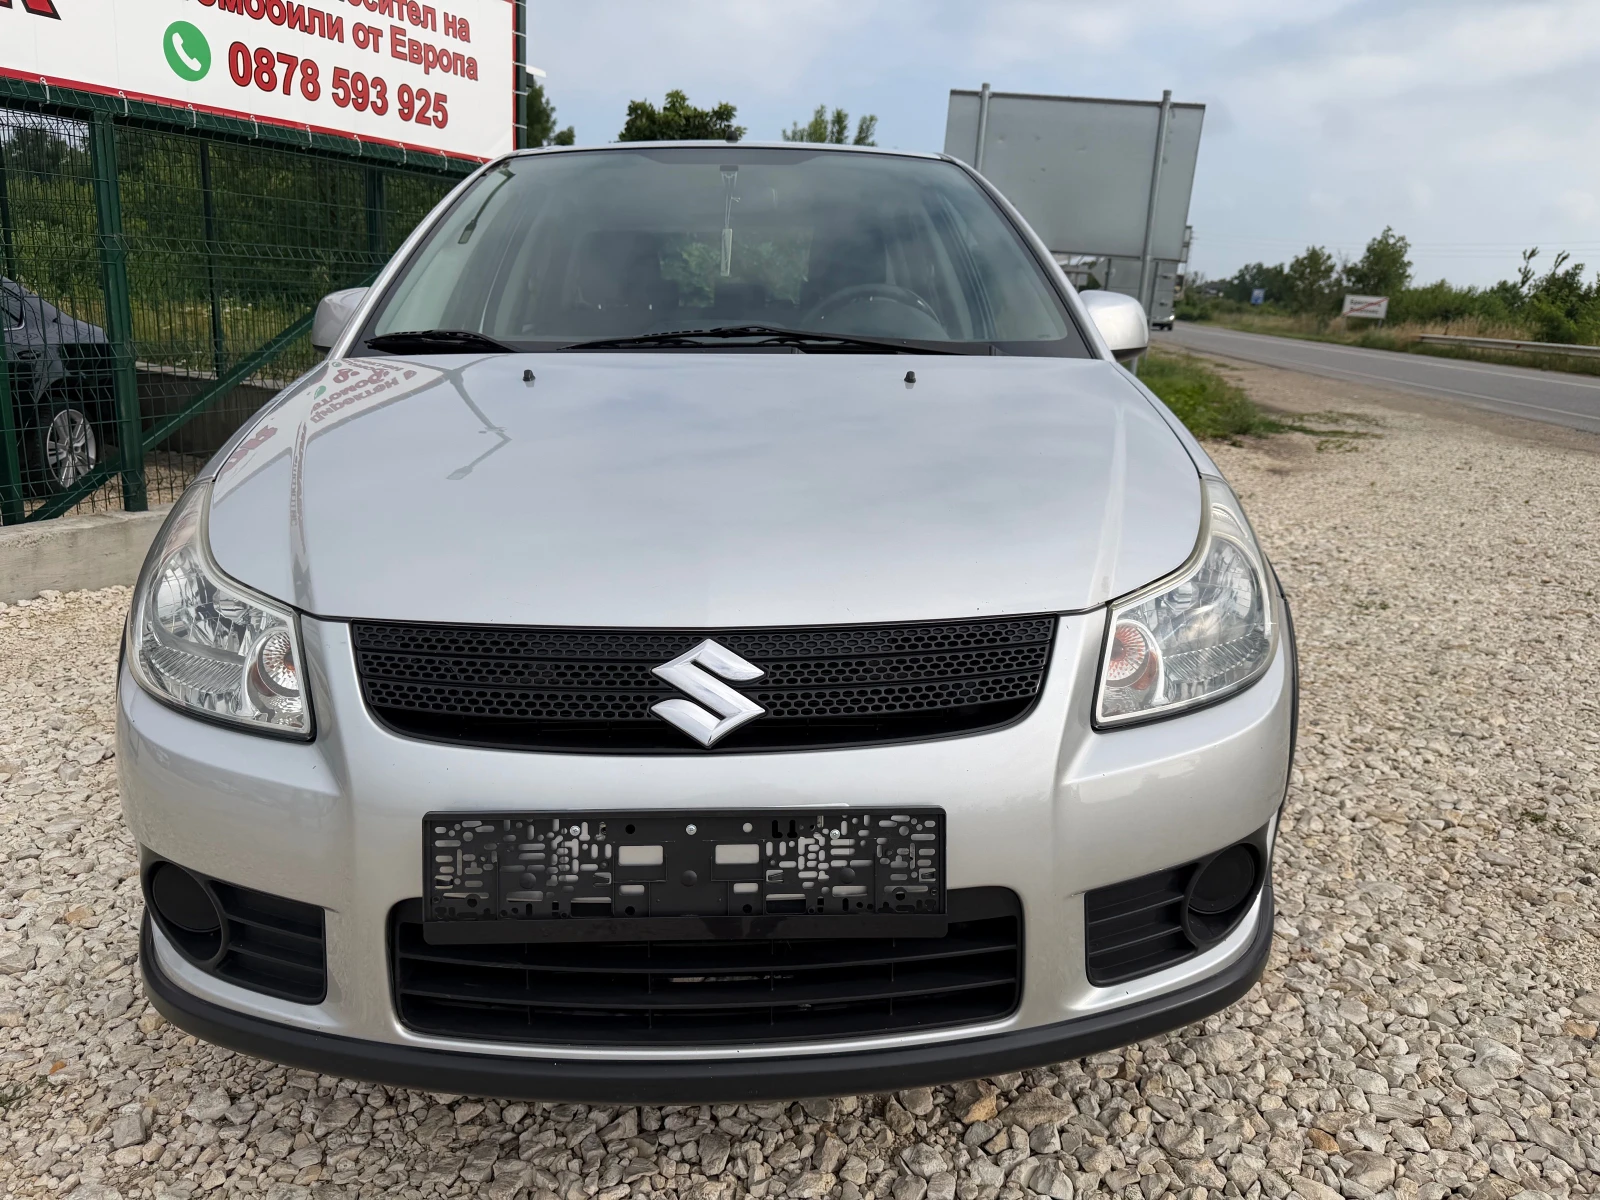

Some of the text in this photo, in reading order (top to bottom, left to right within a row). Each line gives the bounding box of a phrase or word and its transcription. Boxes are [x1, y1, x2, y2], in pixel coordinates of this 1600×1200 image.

[352, 22, 383, 53] от
[390, 25, 478, 81] Европа
[443, 12, 471, 43] на
[228, 41, 448, 129] 0878 593 925
